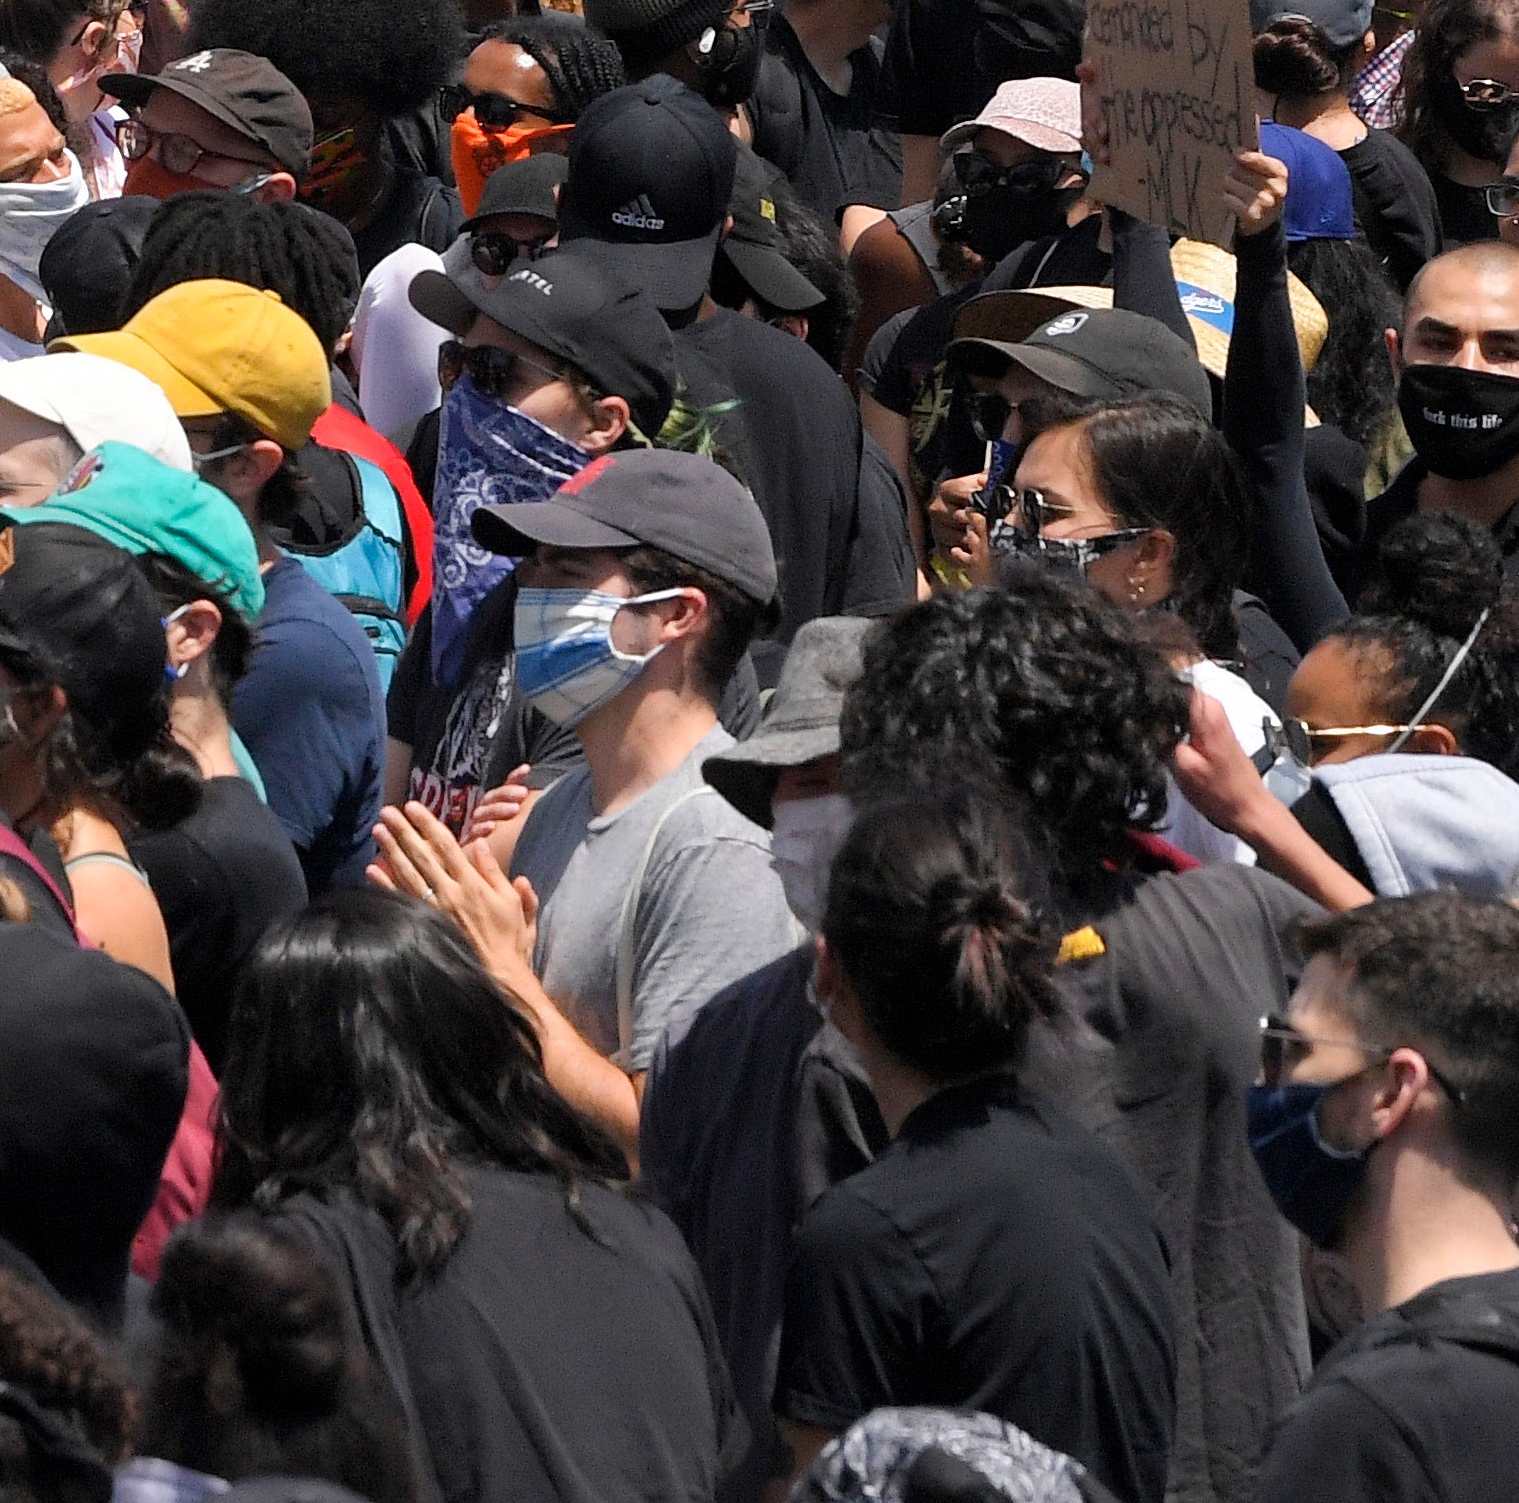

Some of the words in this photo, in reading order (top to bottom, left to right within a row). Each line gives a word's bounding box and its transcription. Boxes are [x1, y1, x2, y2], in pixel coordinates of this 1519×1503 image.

[612, 212, 664, 229] adidas
[1451, 411, 1478, 428] this
[1482, 414, 1503, 429] life
